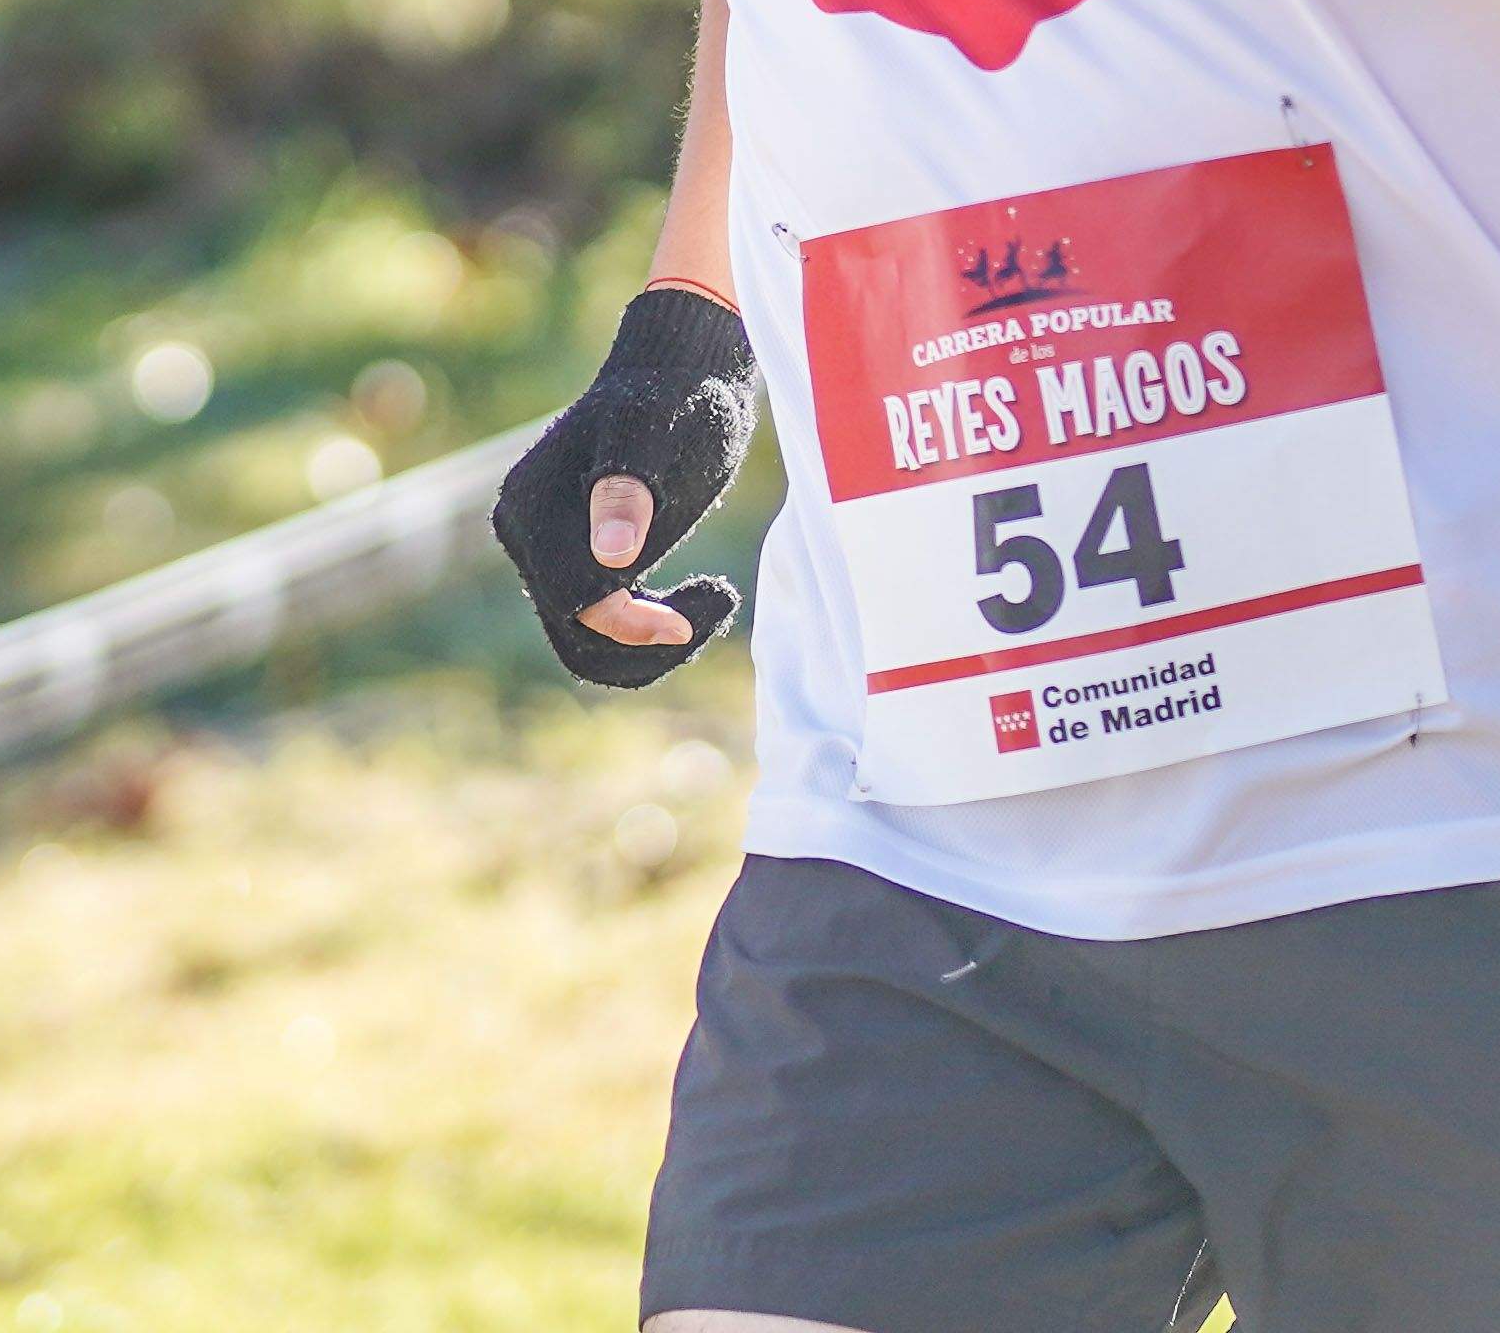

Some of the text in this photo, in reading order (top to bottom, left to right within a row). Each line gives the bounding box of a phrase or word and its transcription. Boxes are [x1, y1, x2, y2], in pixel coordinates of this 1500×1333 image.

[912, 298, 1175, 368] CARRERA POPULAR
[1009, 343, 1056, 365] de los
[883, 330, 1247, 471] REYES MAGOS
[973, 462, 1186, 634] 54
[1042, 652, 1217, 709] Comunidad
[1049, 685, 1222, 744] de Madrid
